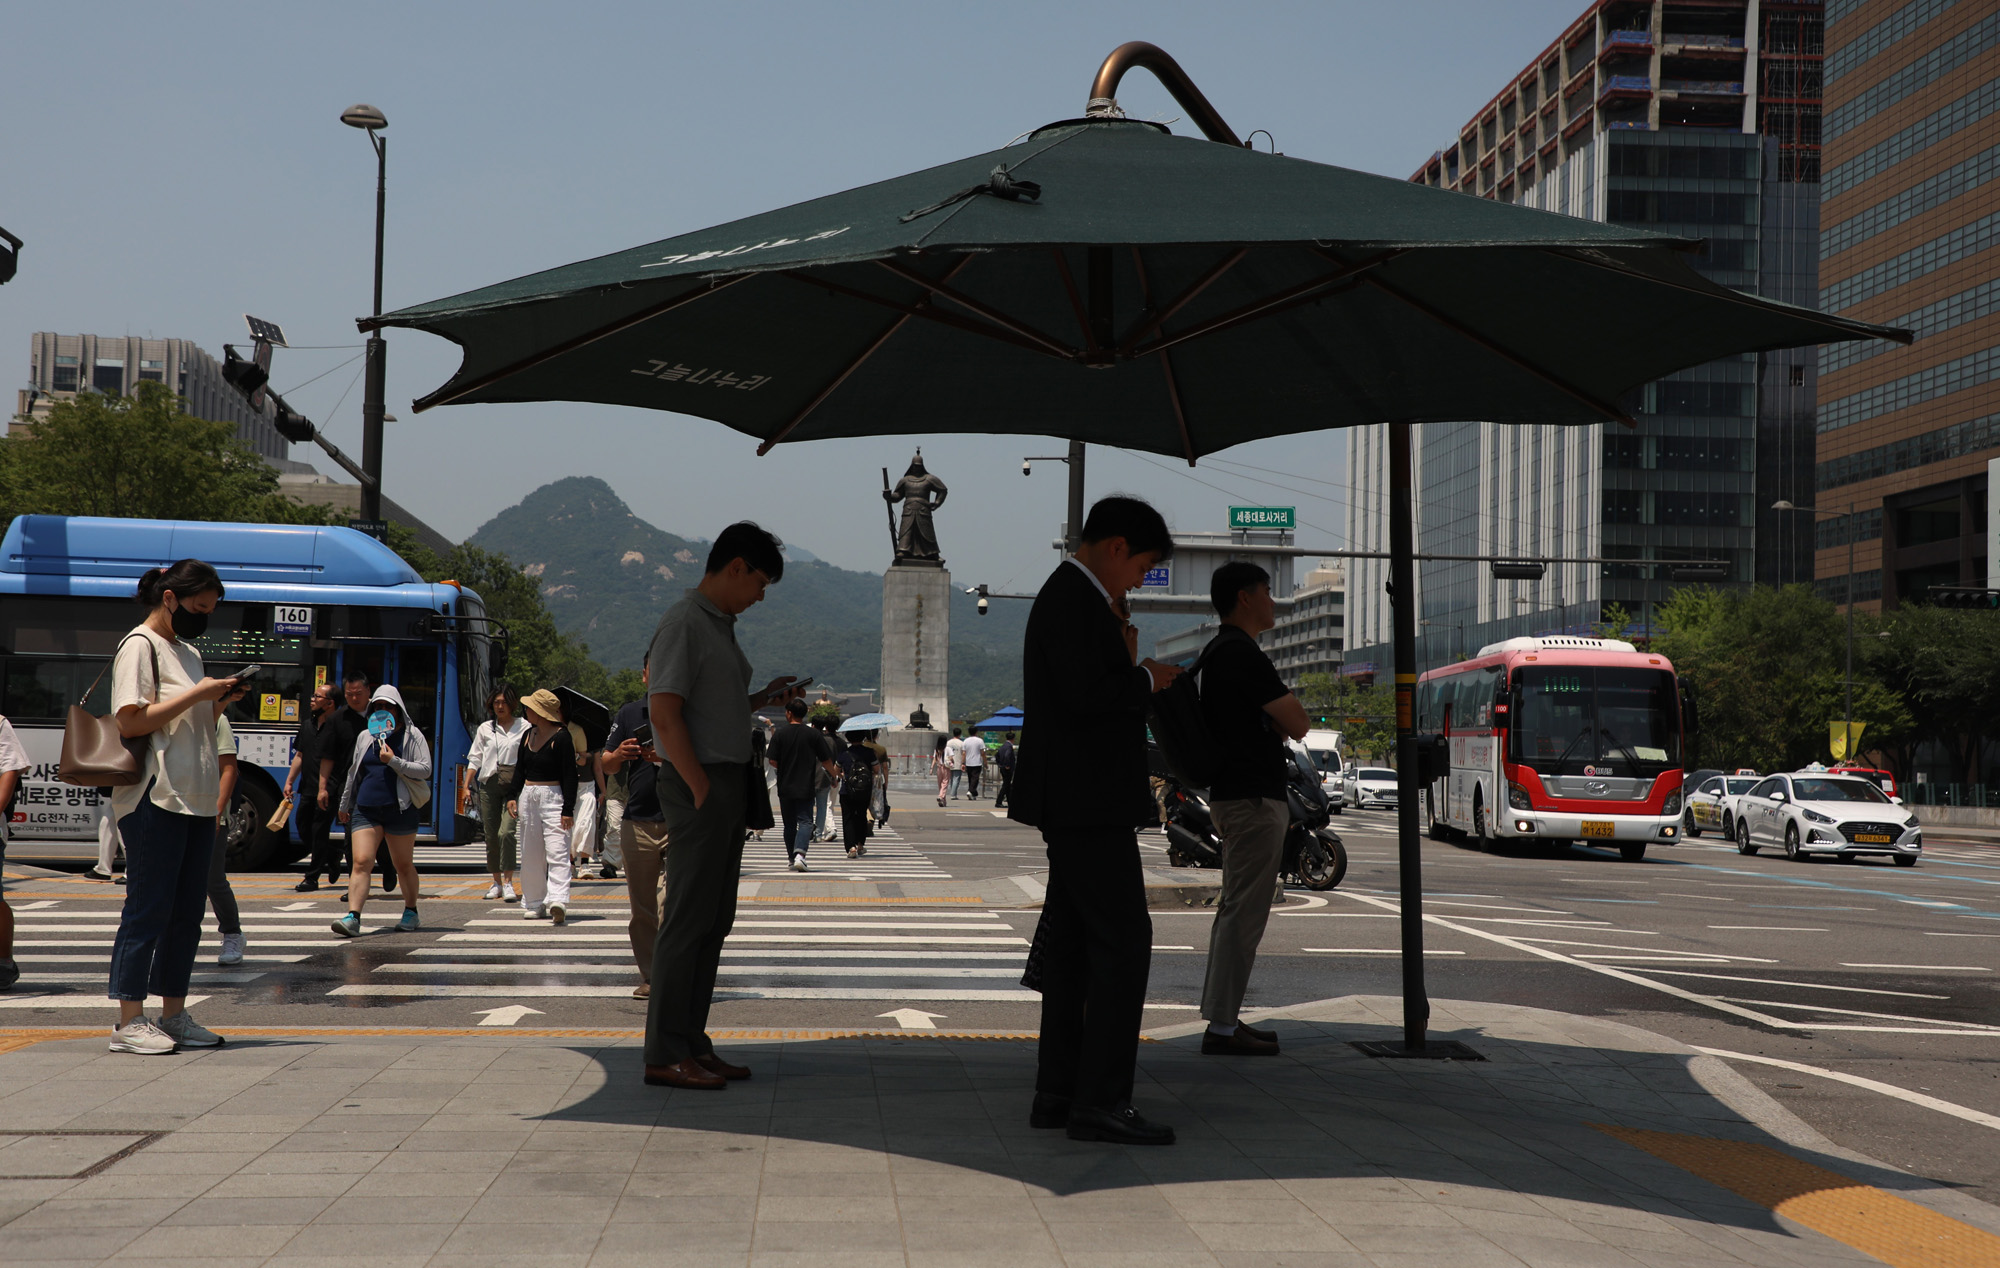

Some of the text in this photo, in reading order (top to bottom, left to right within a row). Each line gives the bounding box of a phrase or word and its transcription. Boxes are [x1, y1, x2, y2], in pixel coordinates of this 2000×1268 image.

[631, 359, 773, 391] 그늘나누리
[1236, 511, 1288, 523] 세종대로사거리
[280, 608, 307, 622] 160
[1544, 676, 1580, 692] 1100
[65, 787, 104, 806] 방법.
[30, 812, 69, 823] LG전자
[71, 813, 91, 824] 구독
[1591, 828, 1612, 837] 1432
